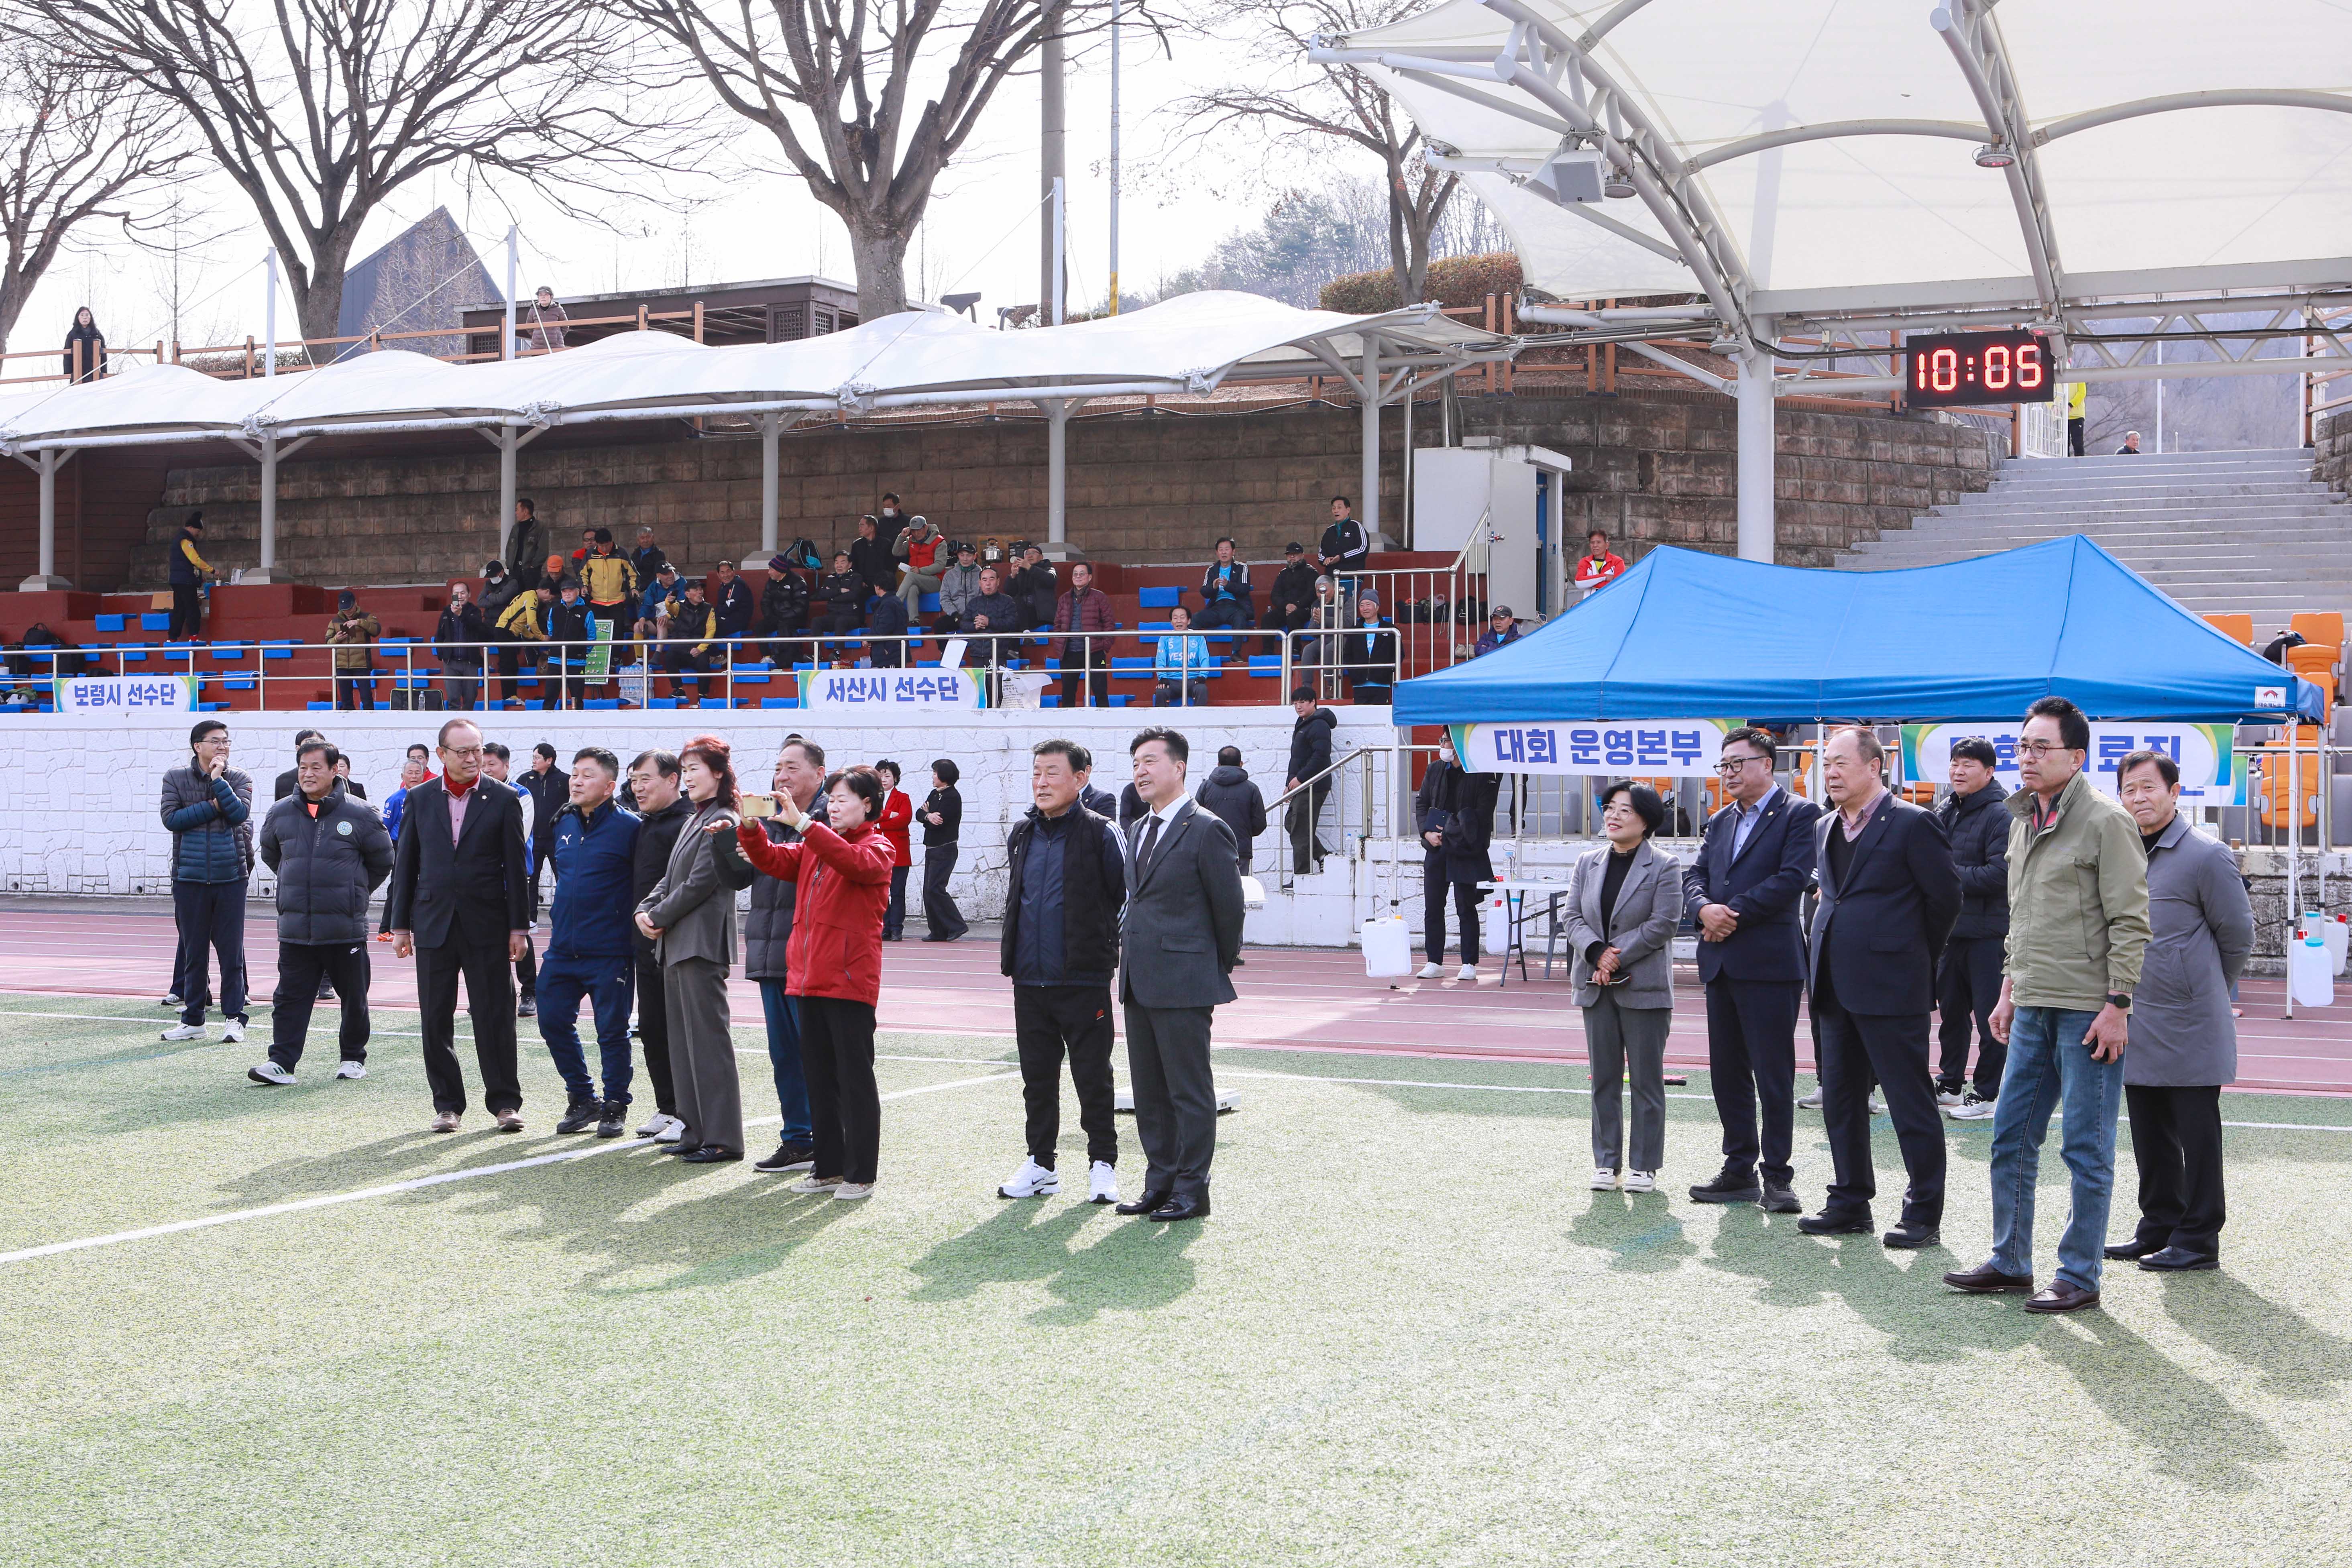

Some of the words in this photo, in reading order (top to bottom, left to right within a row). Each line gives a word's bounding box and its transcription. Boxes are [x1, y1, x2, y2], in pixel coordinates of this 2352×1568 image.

[1918, 344, 2042, 391] 10:05
[1169, 652, 1196, 661] YESN
[74, 684, 120, 706] 보령시
[128, 683, 176, 706] 선수단
[826, 677, 886, 702] 서산시
[895, 676, 959, 702] 선수단
[1494, 729, 1557, 764] 대회
[1570, 730, 1702, 766] 운영본부
